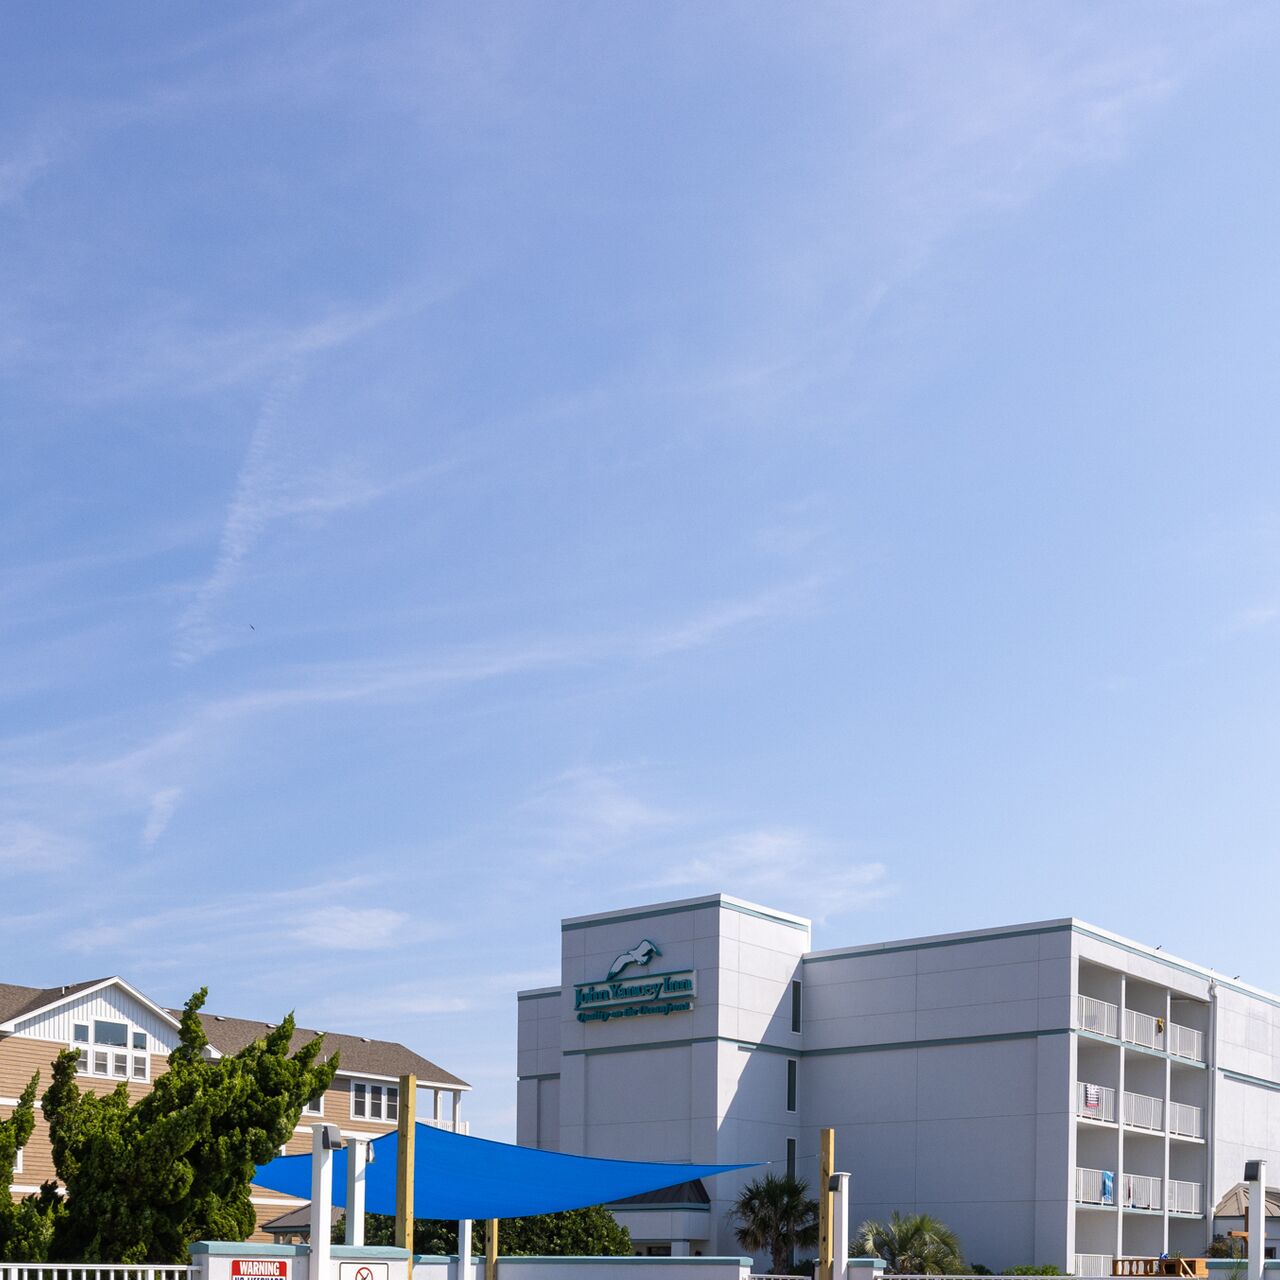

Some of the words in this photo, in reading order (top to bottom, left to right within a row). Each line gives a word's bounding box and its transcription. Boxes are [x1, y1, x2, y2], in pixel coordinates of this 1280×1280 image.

[575, 987, 610, 1008] John
[608, 983, 662, 1000] Yancey
[663, 976, 693, 993] Inn
[239, 1261, 280, 1276] WARNING
